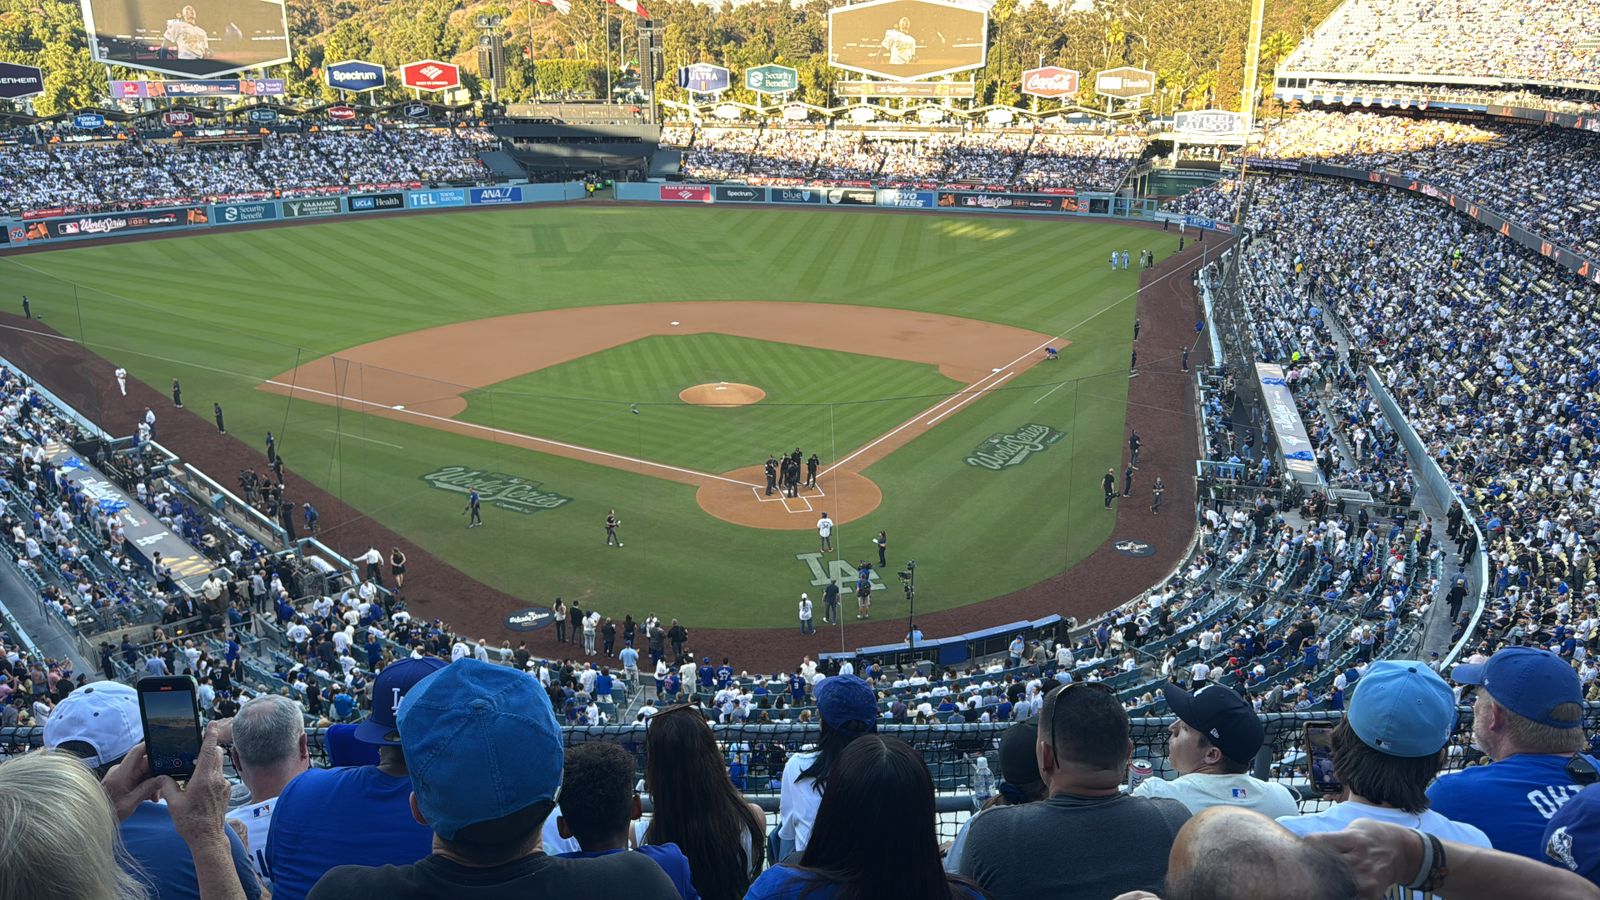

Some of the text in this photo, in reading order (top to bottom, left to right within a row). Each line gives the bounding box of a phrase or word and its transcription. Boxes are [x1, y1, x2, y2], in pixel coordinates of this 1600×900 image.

[333, 70, 376, 81] Spectrum
[689, 72, 718, 81] ULTRA
[765, 72, 793, 80] Security
[765, 80, 790, 88] Benefit
[170, 113, 189, 122] JINRO
[481, 190, 501, 198] ANA
[782, 190, 800, 199] blue
[376, 198, 399, 206] Health
[410, 194, 437, 206] TEL
[240, 205, 264, 214] Security
[102, 218, 126, 232] Series
[12, 230, 24, 238] 76
